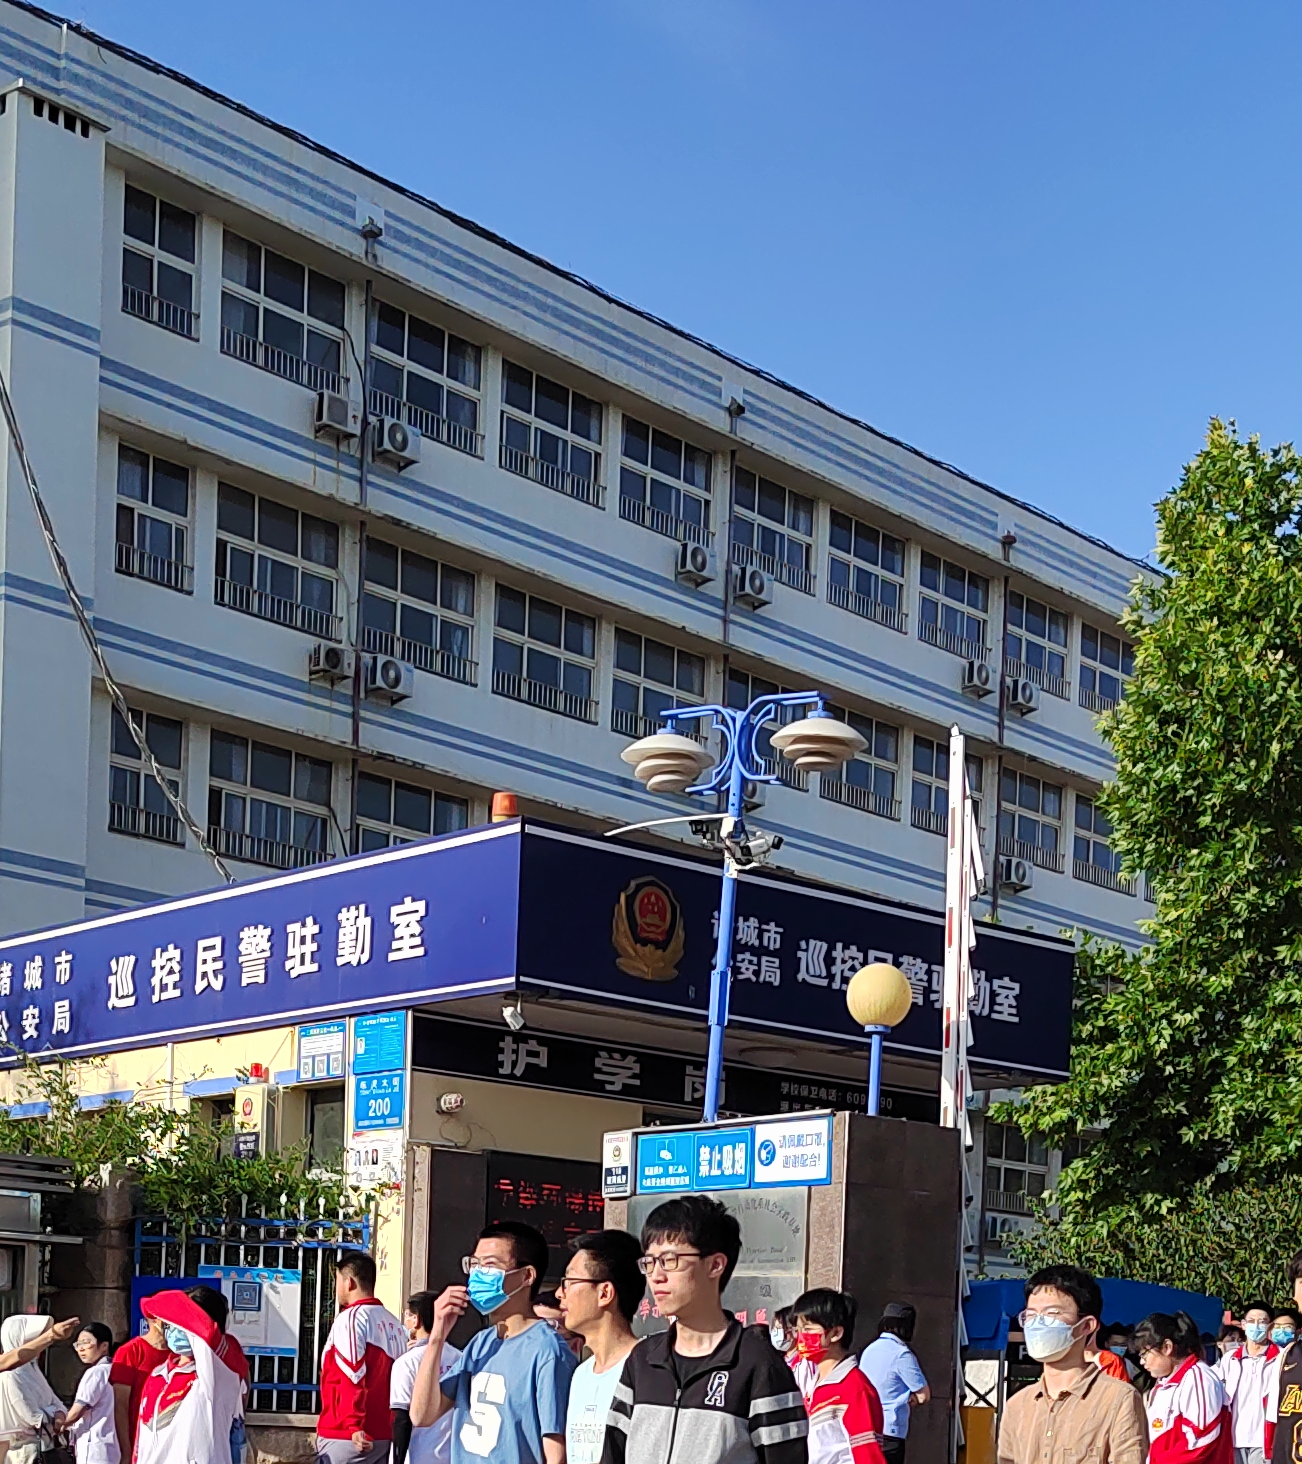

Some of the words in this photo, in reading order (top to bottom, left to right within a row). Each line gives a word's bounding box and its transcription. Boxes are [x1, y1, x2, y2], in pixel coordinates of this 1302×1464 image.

[108, 896, 426, 1010] 巡控民警驻勤室
[498, 1035, 726, 1106] 护学岗
[368, 1097, 391, 1117] 200
[699, 1142, 746, 1177] 禁止吸烟
